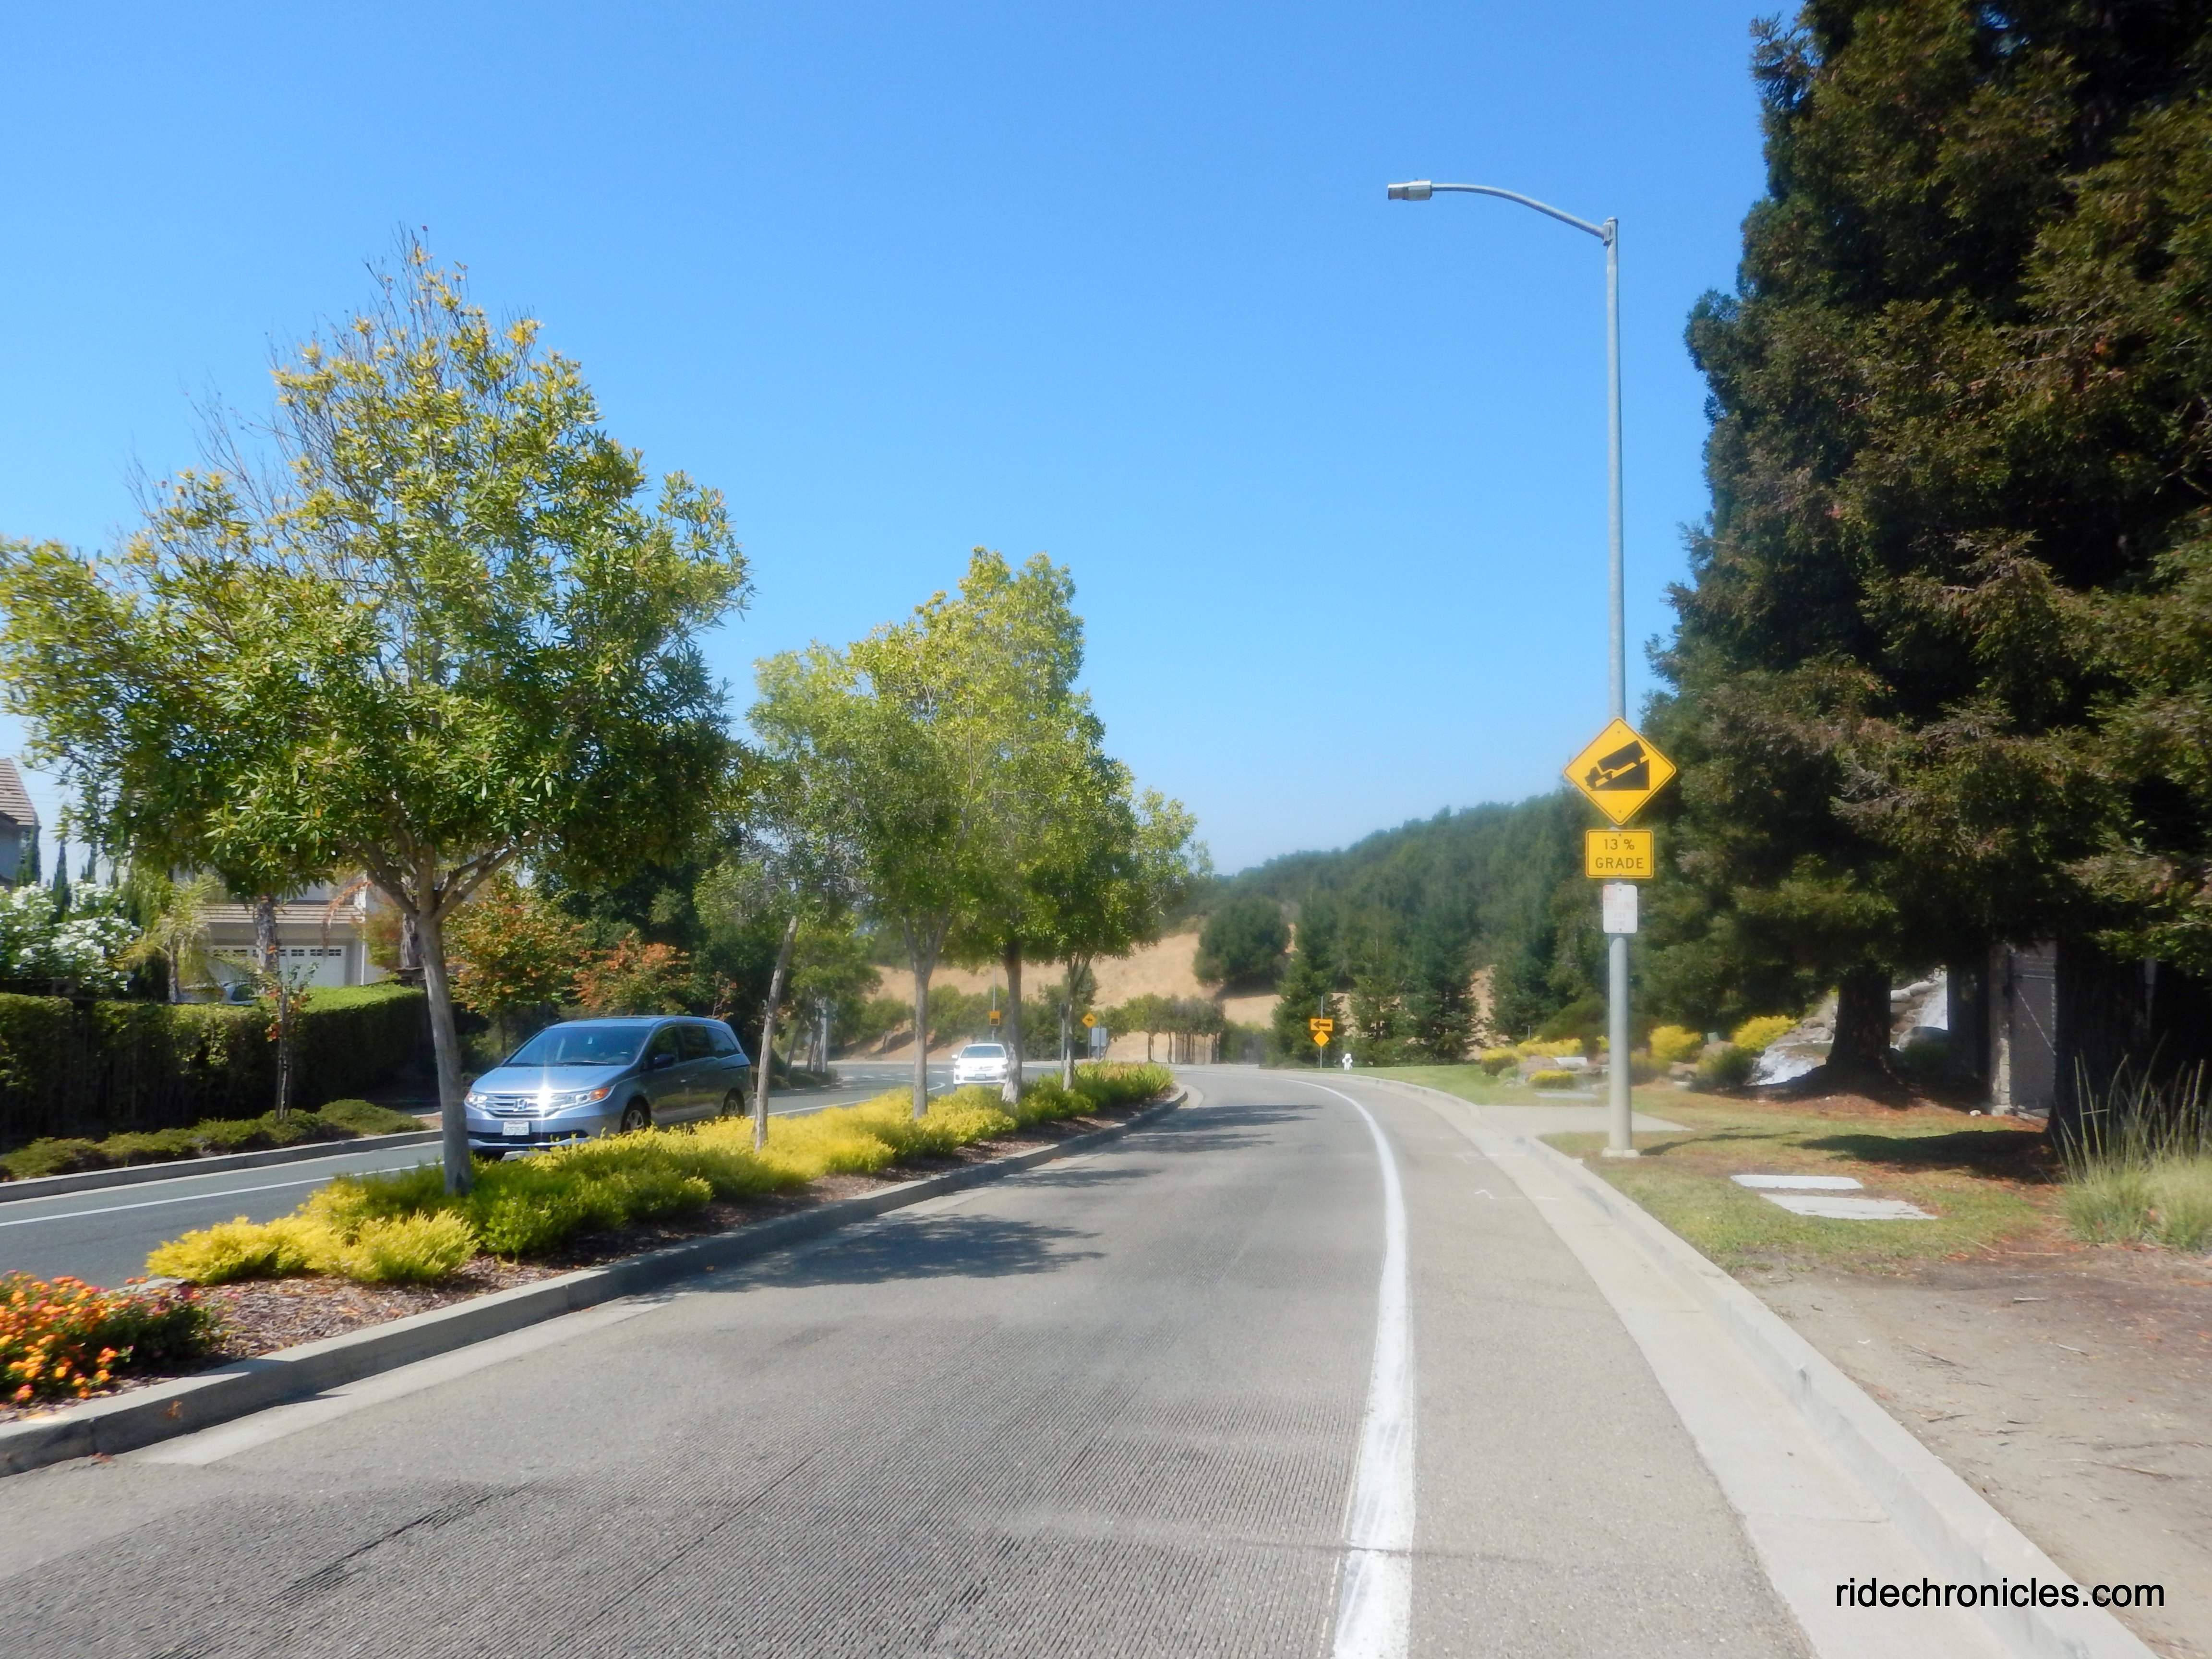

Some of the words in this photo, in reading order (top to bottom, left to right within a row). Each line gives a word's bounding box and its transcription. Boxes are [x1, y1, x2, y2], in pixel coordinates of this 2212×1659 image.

[1604, 839, 1618, 850] 13
[1623, 839, 1635, 850] %
[1595, 857, 1644, 869] GRADE
